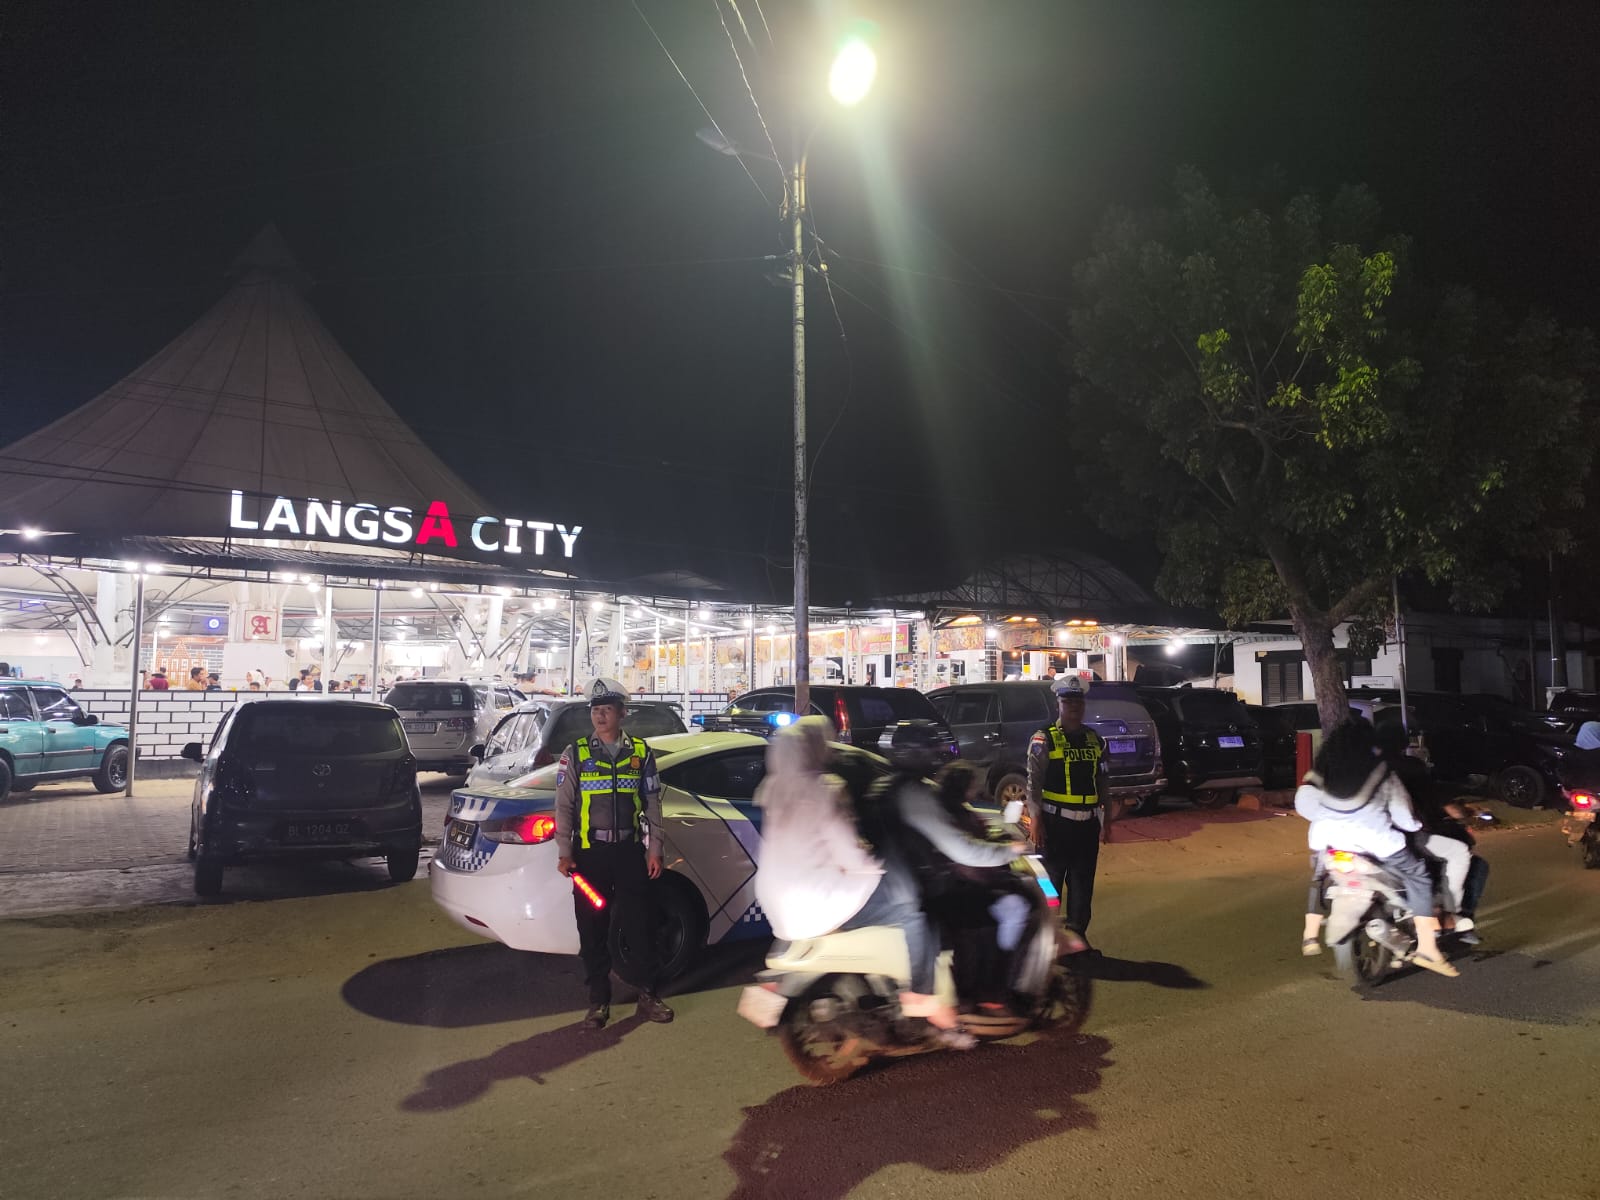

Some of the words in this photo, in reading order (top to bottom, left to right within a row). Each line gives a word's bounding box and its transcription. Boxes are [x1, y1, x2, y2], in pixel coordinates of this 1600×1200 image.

[230, 490, 458, 547] LANGSA
[471, 516, 583, 557] CITY
[1063, 748, 1096, 761] POLISI
